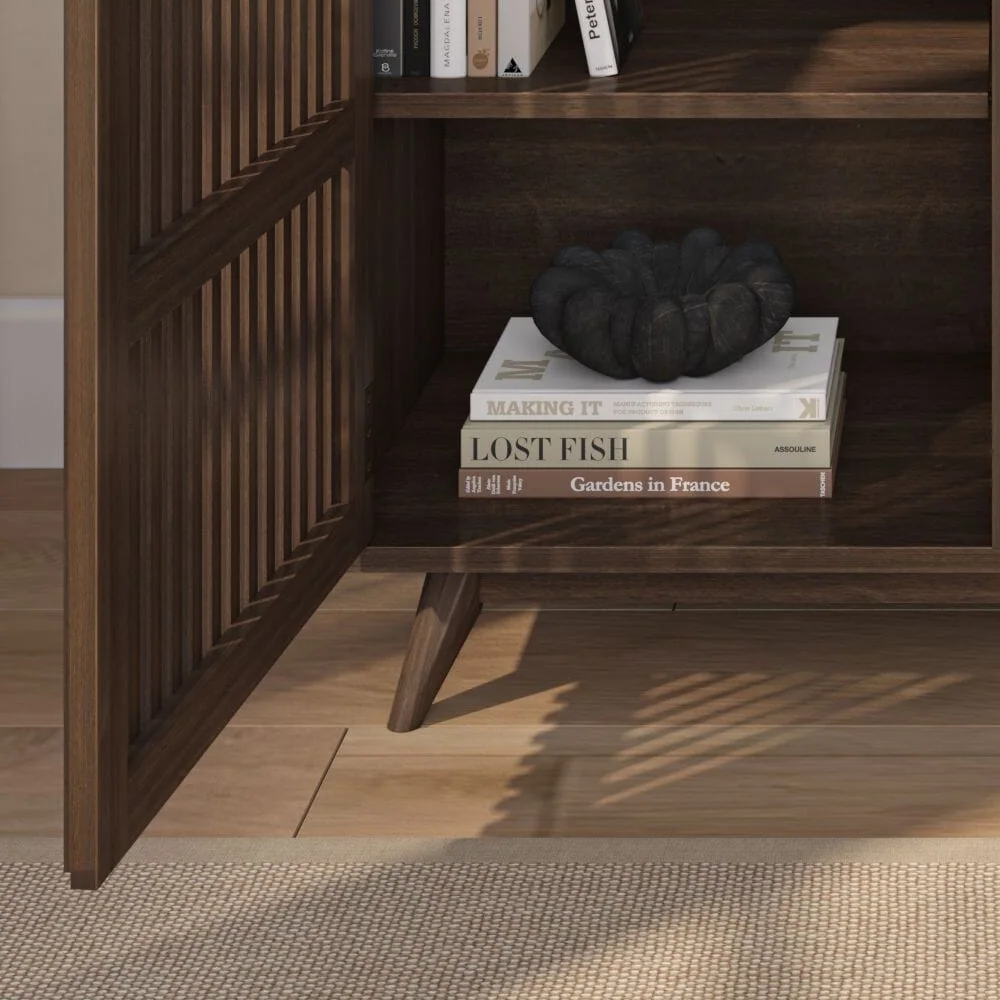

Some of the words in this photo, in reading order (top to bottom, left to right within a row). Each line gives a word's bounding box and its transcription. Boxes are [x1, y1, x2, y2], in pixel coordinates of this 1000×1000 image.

[486, 400, 574, 416] MAKING
[580, 400, 603, 416] IT
[471, 437, 552, 462] LOST
[561, 437, 629, 462] FISH
[774, 445, 817, 454] ASSOULINE
[570, 476, 644, 492] Gardens
[647, 476, 666, 492] in
[669, 476, 731, 492] France
